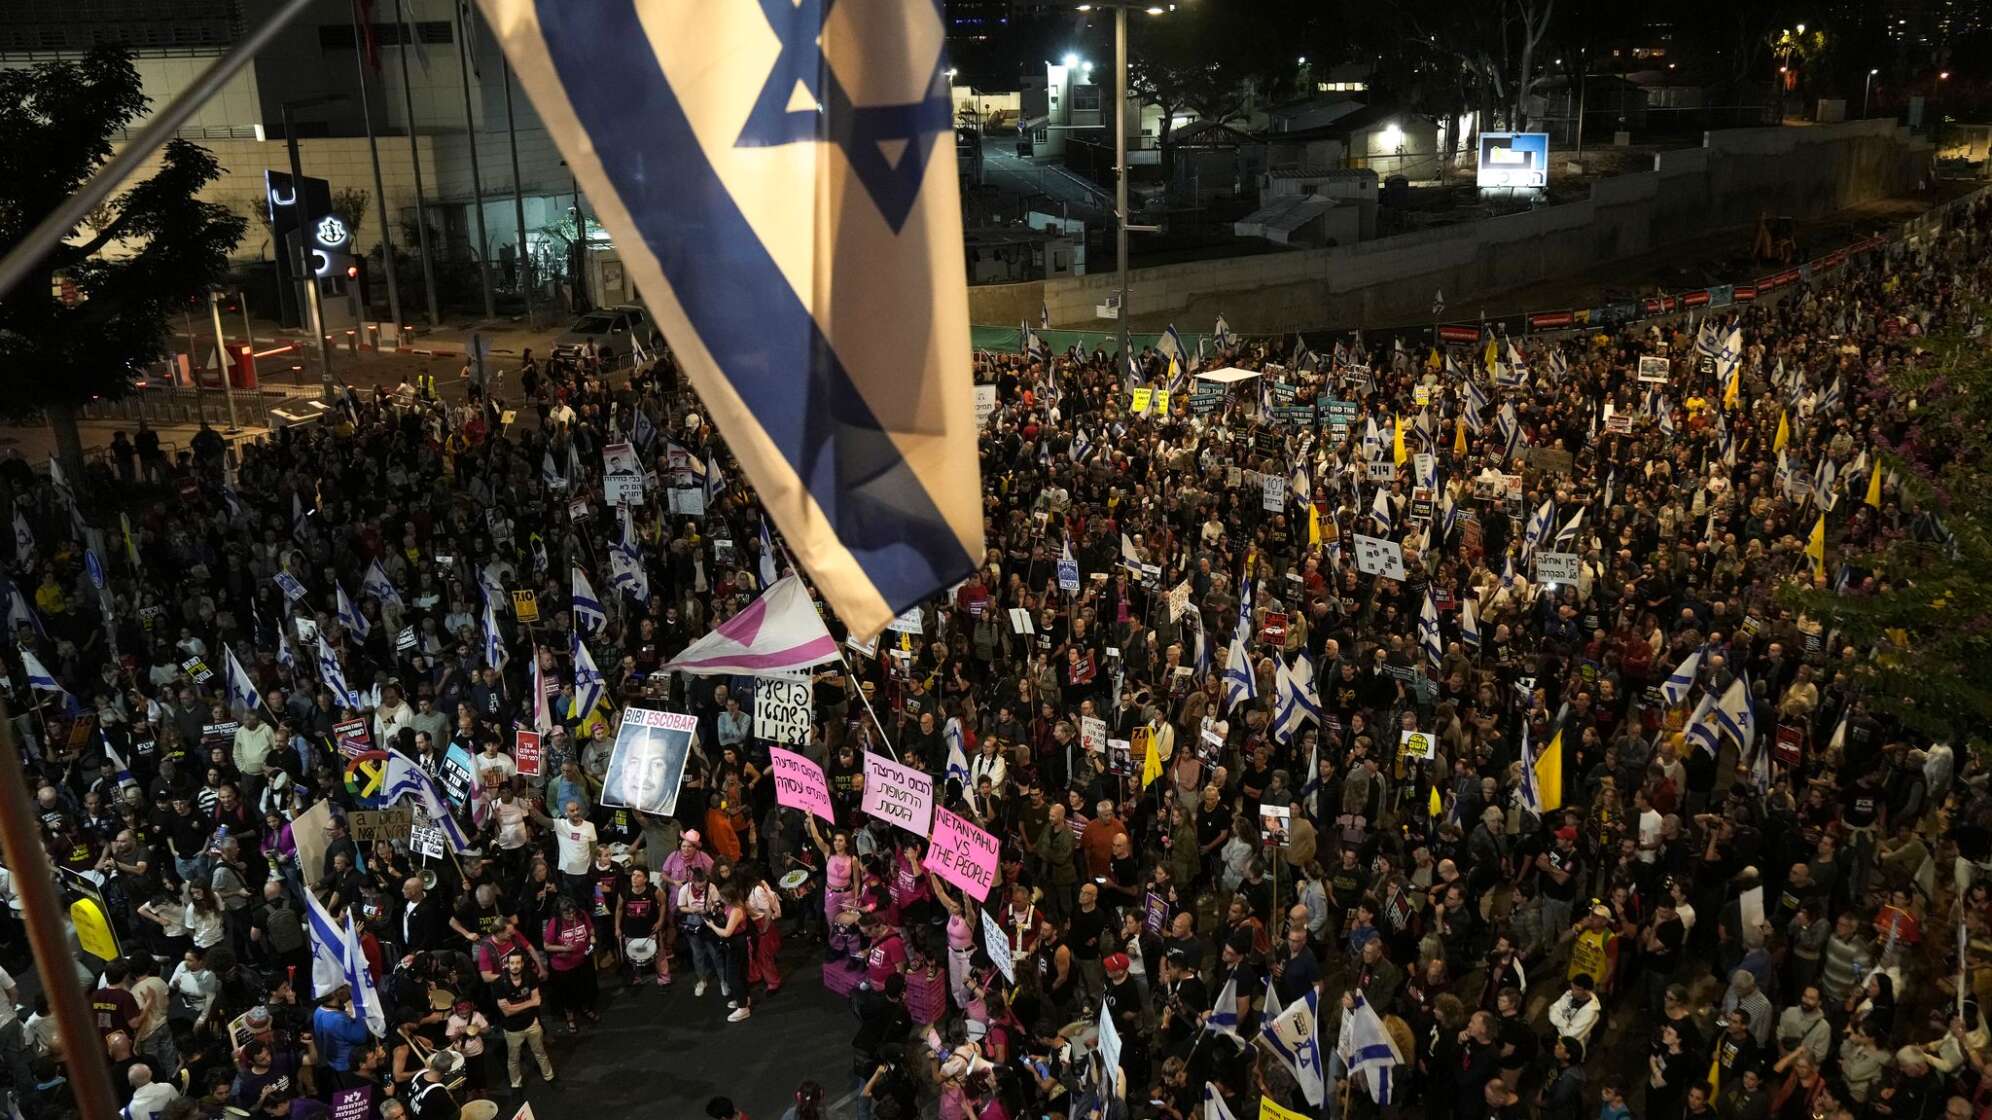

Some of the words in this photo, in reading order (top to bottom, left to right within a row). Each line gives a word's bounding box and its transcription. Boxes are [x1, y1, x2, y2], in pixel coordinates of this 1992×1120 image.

[1371, 465, 1389, 476] 414
[514, 592, 533, 602] 7.10
[755, 677, 809, 707] פושעים
[624, 709, 645, 724] BIBI
[647, 712, 696, 731] ESCOBAR
[759, 702, 810, 727] השתלטו
[762, 721, 810, 744] עלינו
[937, 808, 997, 855] NETANYAHU
[931, 842, 953, 867] THE
[953, 855, 992, 889] PEOPLE
[344, 1091, 361, 1104] לא
